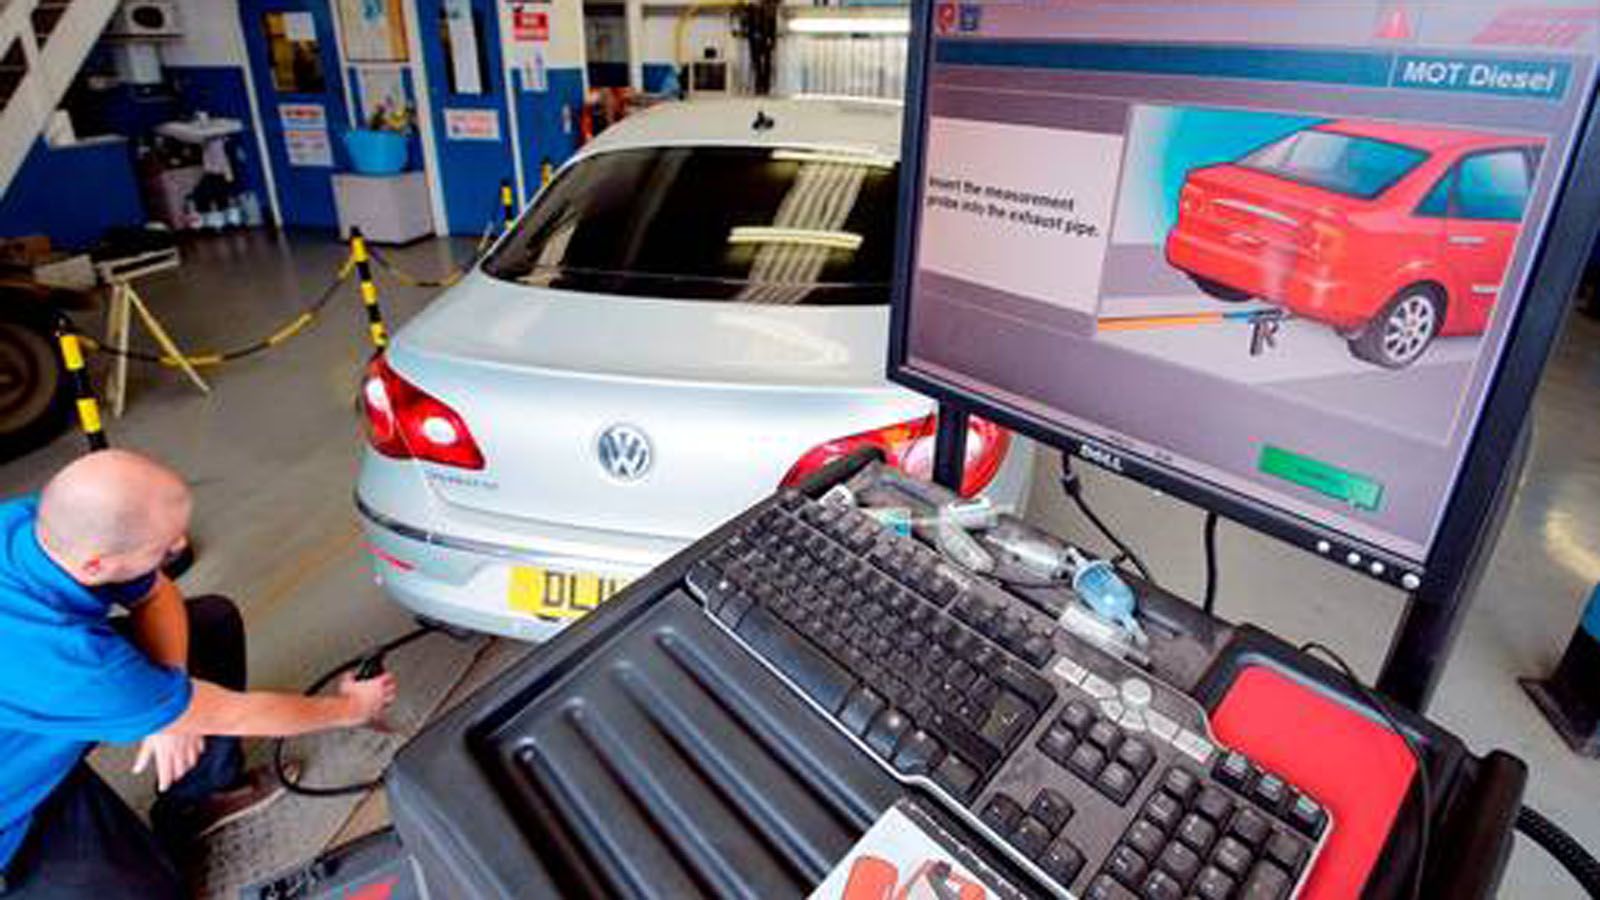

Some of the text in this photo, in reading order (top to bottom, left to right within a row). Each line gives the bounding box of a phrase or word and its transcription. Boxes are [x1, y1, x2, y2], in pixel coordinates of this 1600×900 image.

[1403, 61, 1556, 92] MOT Diesel
[963, 179, 982, 195] the
[984, 185, 1075, 213] measurement
[961, 199, 986, 217] into
[987, 203, 1006, 218] the
[1009, 208, 1062, 230] exhaust
[1064, 219, 1100, 238] pipe.
[1081, 444, 1123, 472] DELL
